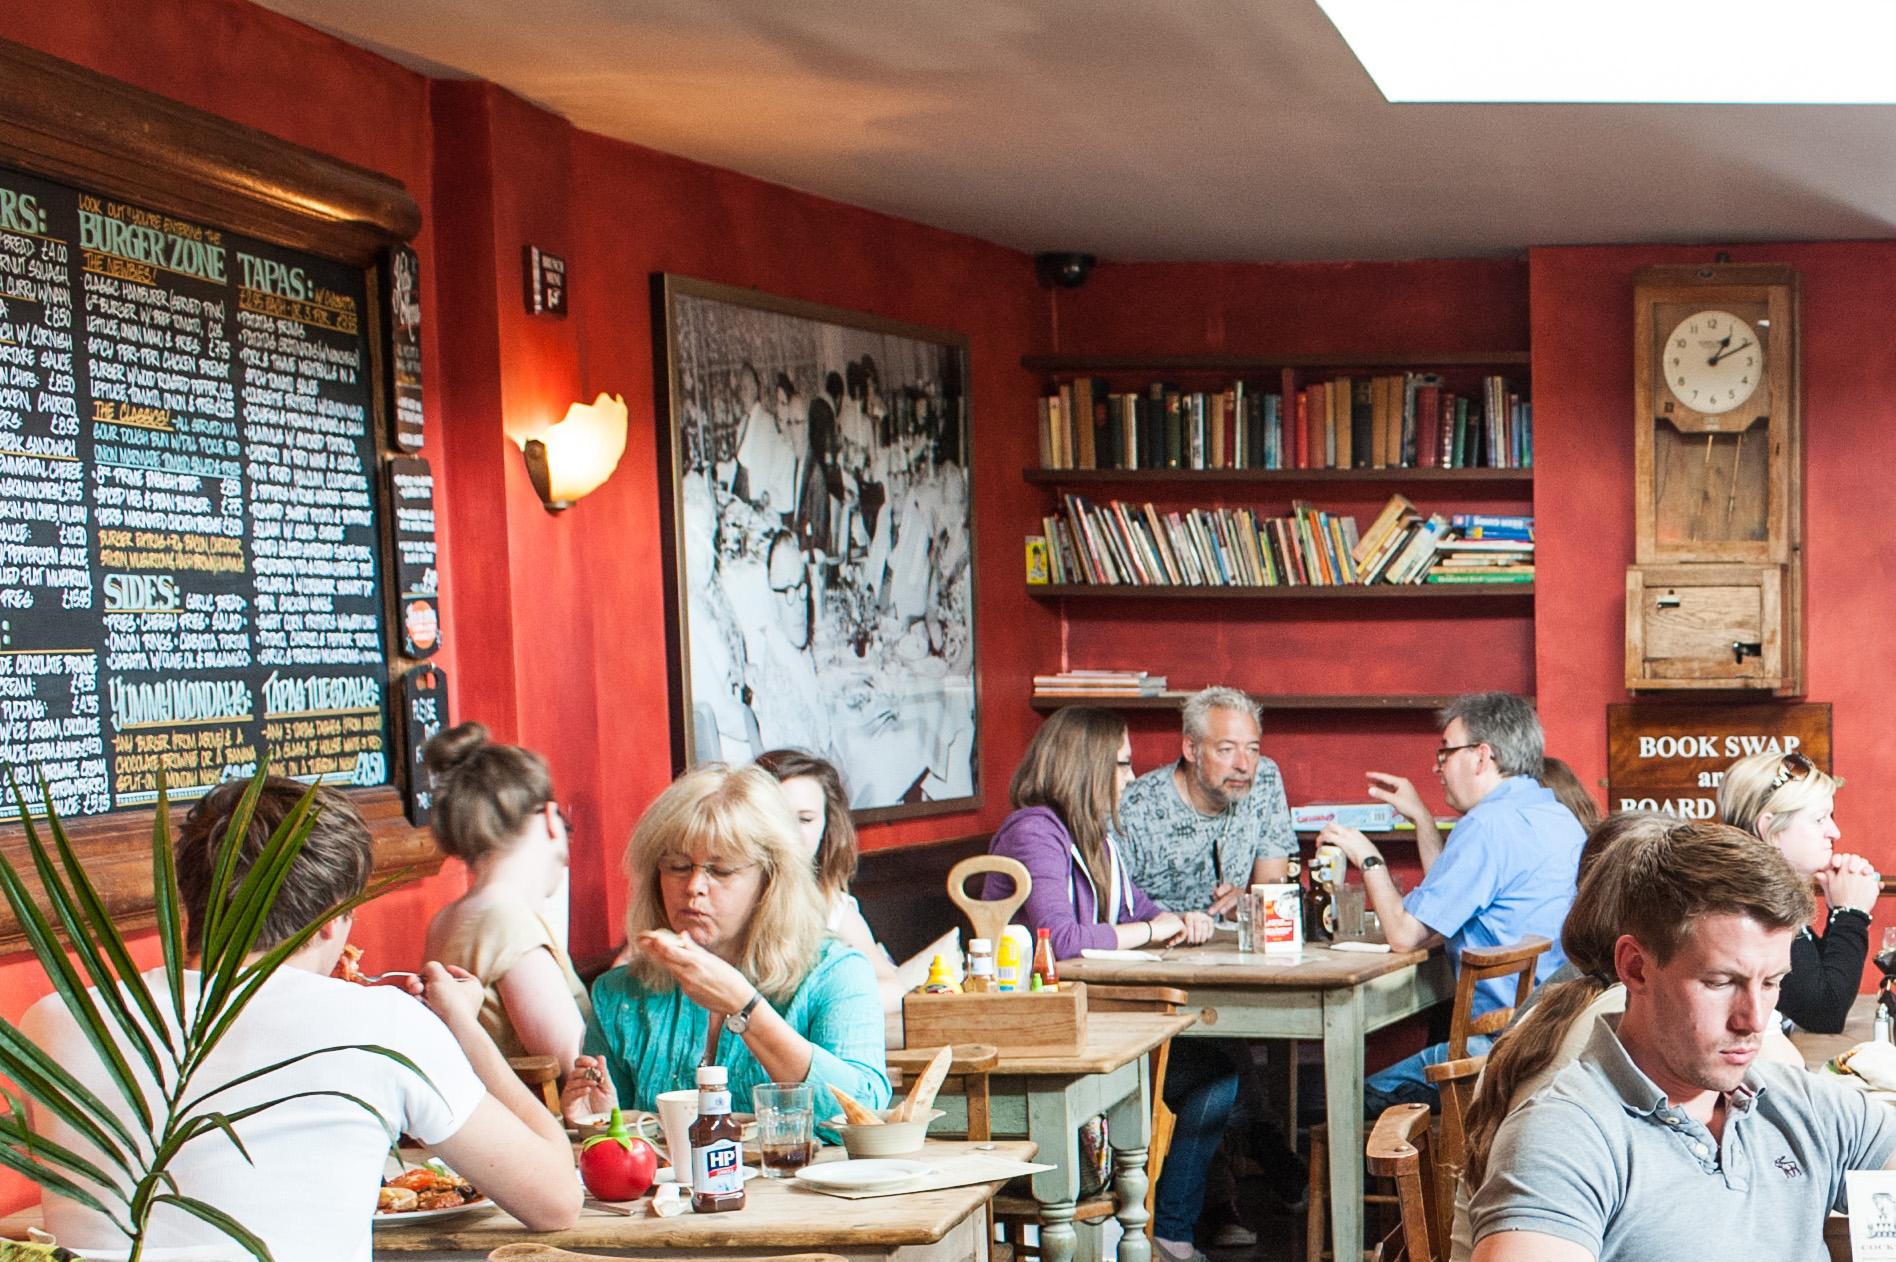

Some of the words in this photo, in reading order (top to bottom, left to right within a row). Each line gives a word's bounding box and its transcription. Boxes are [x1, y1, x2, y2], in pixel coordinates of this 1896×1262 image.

[79, 192, 102, 214] LOOK
[78, 209, 168, 268] BURGER
[168, 233, 227, 283] ZONE
[83, 252, 103, 271] THE
[236, 251, 314, 300] TAPAS:
[89, 359, 125, 381] BURGER
[162, 351, 196, 373] CHICKEN
[199, 357, 230, 379] BREAST
[93, 401, 115, 418] THE
[26, 435, 76, 457] SANDWICH
[120, 427, 149, 446] DOUGH
[48, 461, 84, 480] CHEESE
[103, 574, 180, 609] SIDES:
[212, 612, 243, 631] SALAD
[109, 633, 140, 652] ONION
[142, 633, 174, 651] RINGS
[262, 670, 306, 713] TAPAS
[108, 675, 173, 732] YUMMY
[135, 734, 170, 751] BURGER
[1639, 736, 1720, 759] BOOK
[1725, 735, 1800, 759] SWAP
[1698, 772, 1724, 788] an
[709, 1150, 736, 1168] HP
